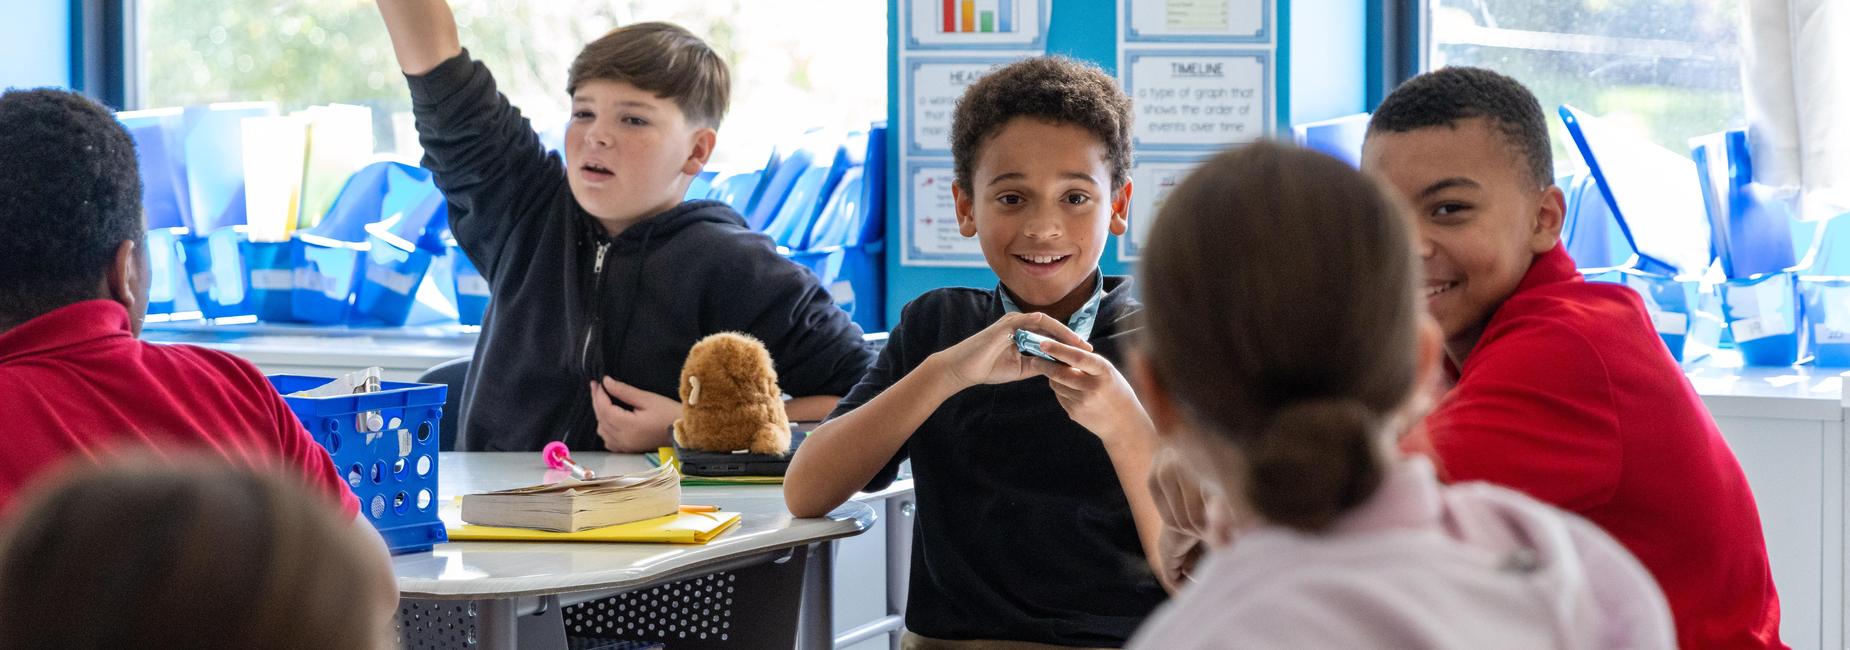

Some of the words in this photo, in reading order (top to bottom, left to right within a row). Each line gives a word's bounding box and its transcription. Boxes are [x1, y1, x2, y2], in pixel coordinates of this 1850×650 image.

[1171, 62, 1224, 75] TIMELINE
[1139, 89, 1147, 98] a
[1151, 87, 1175, 100] type
[1178, 86, 1190, 98] of
[1194, 86, 1227, 101] graph
[1231, 87, 1254, 98] that
[1144, 103, 1177, 115] shows
[1182, 103, 1200, 115] the
[1204, 103, 1233, 115] order
[1239, 102, 1251, 115] of
[1148, 121, 1186, 133] events
[1190, 121, 1214, 133] over
[1220, 120, 1244, 133] time
